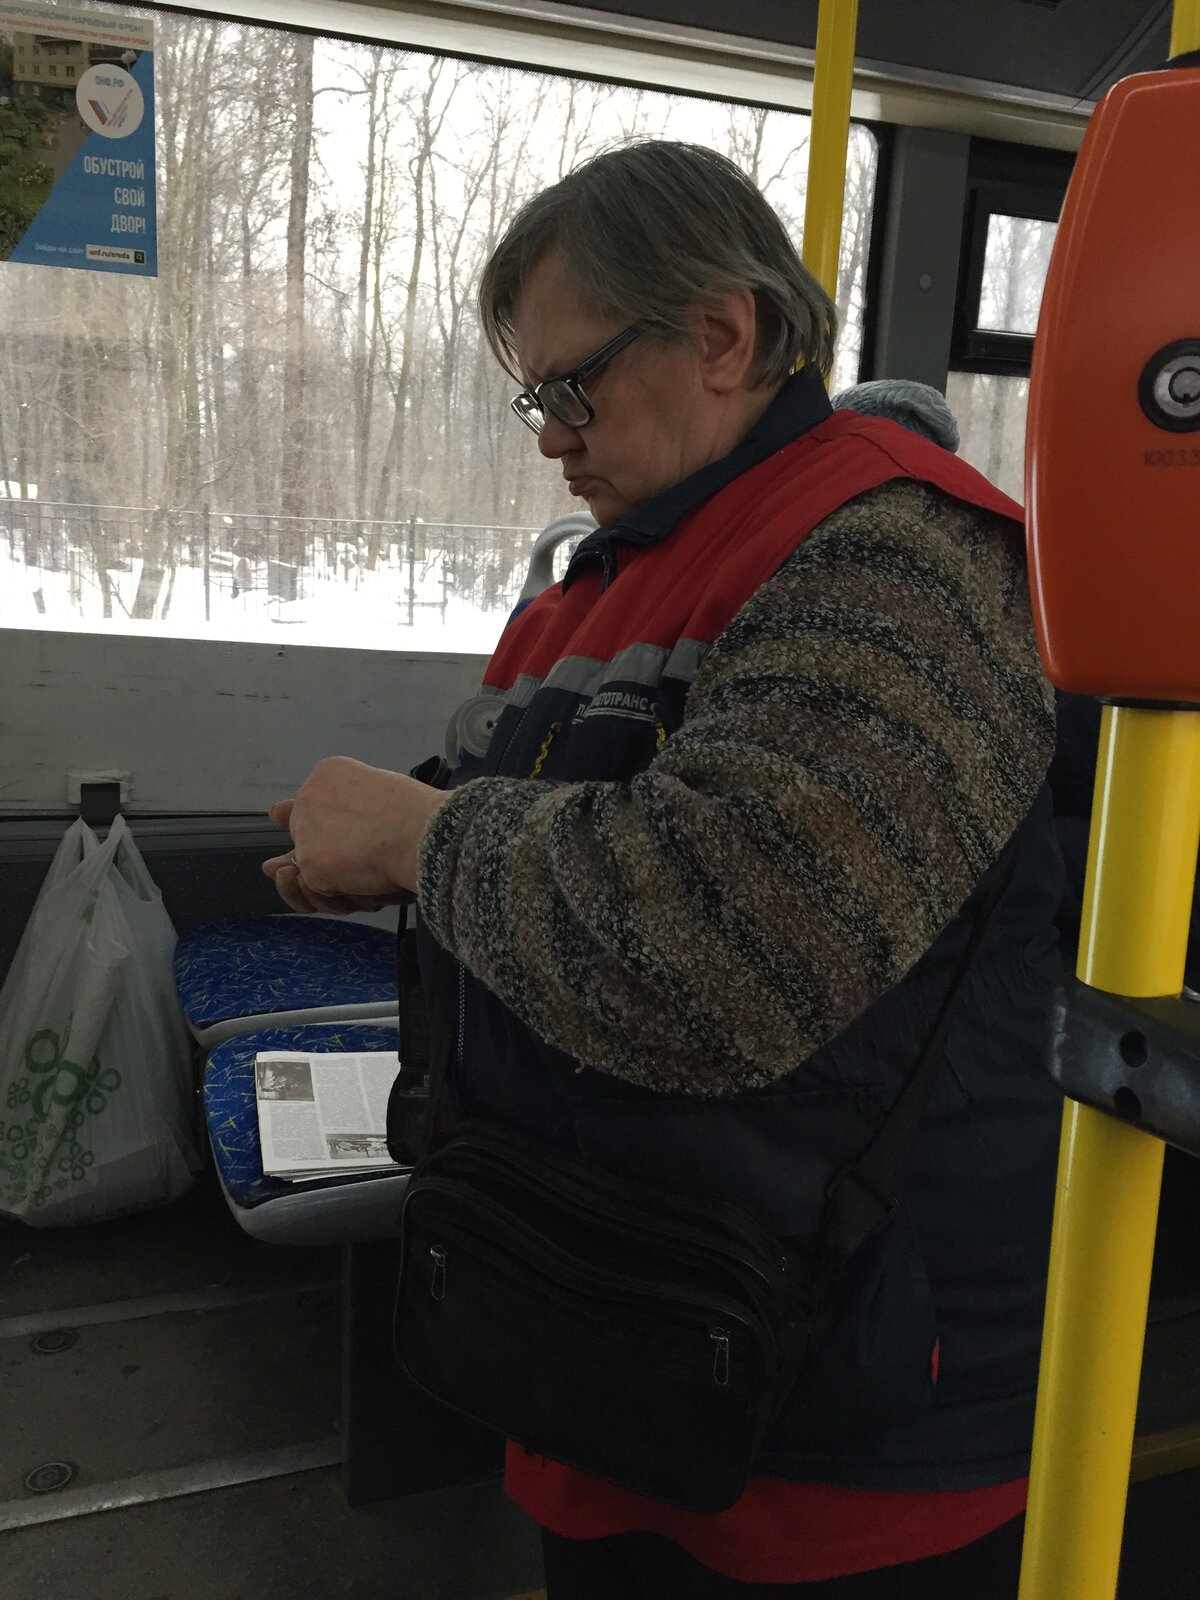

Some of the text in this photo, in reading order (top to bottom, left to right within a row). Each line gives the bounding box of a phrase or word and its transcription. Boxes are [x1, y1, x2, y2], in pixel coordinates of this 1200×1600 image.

[83, 156, 145, 180] ОБУСТРОЙ
[114, 186, 145, 208] СВОЙ
[110, 213, 146, 234] ДВОР!
